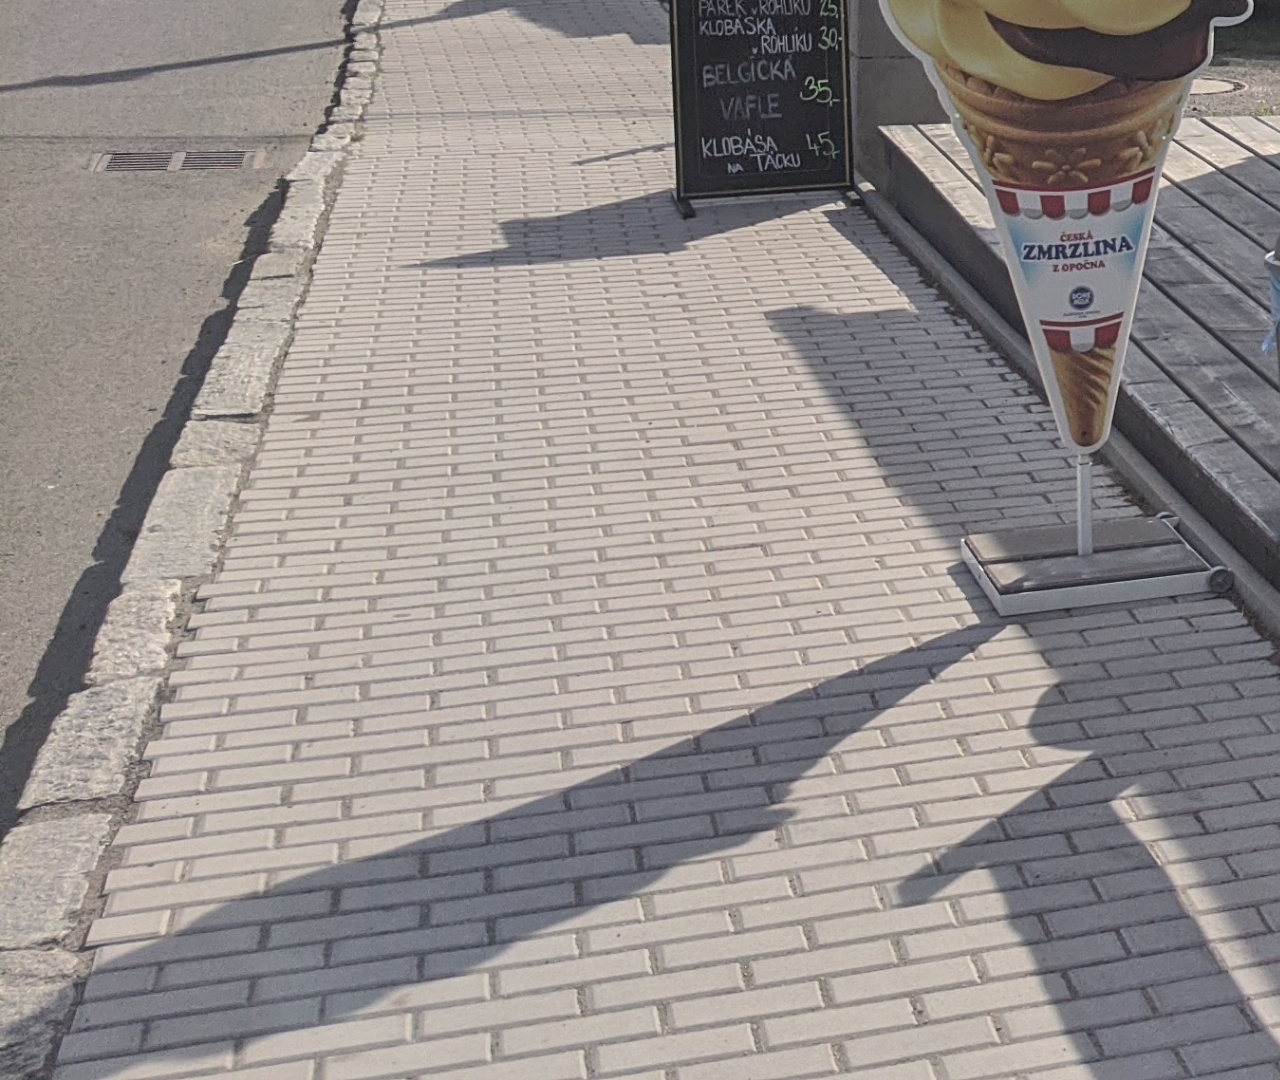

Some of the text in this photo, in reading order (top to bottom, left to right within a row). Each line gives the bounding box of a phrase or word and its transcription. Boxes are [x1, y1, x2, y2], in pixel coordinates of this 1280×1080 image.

[761, 26, 812, 54] ROHLÍKU
[720, 93, 782, 120] VAFLE
[701, 128, 778, 159] KLOBÁSA
[1022, 235, 1134, 261] ZMRZLINA
[1060, 230, 1094, 243] ČESKÁ
[1053, 260, 1106, 273] Z OPOČNA
